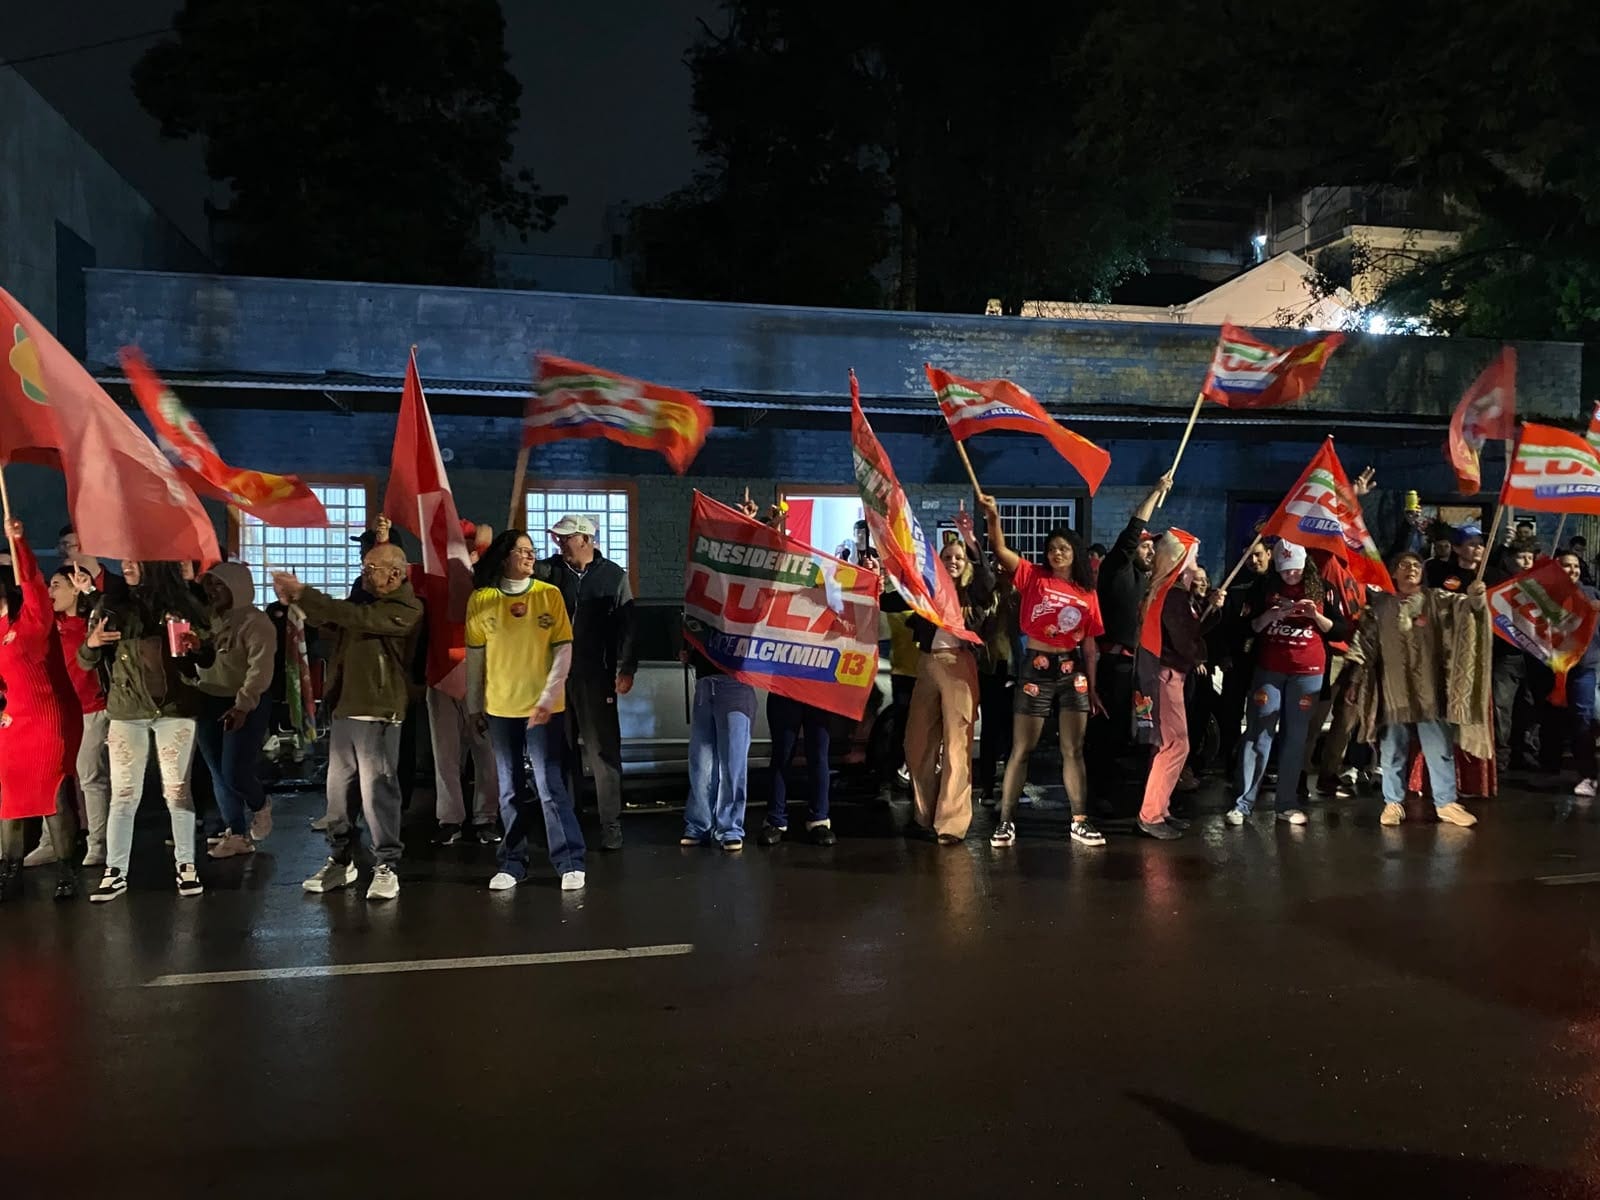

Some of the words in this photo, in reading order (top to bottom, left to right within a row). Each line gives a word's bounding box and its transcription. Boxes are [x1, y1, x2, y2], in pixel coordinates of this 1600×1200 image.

[695, 535, 813, 577] PRESIDENTE
[685, 570, 857, 638] LULA
[733, 637, 834, 669] ALCKMIN
[841, 652, 867, 676] 13
